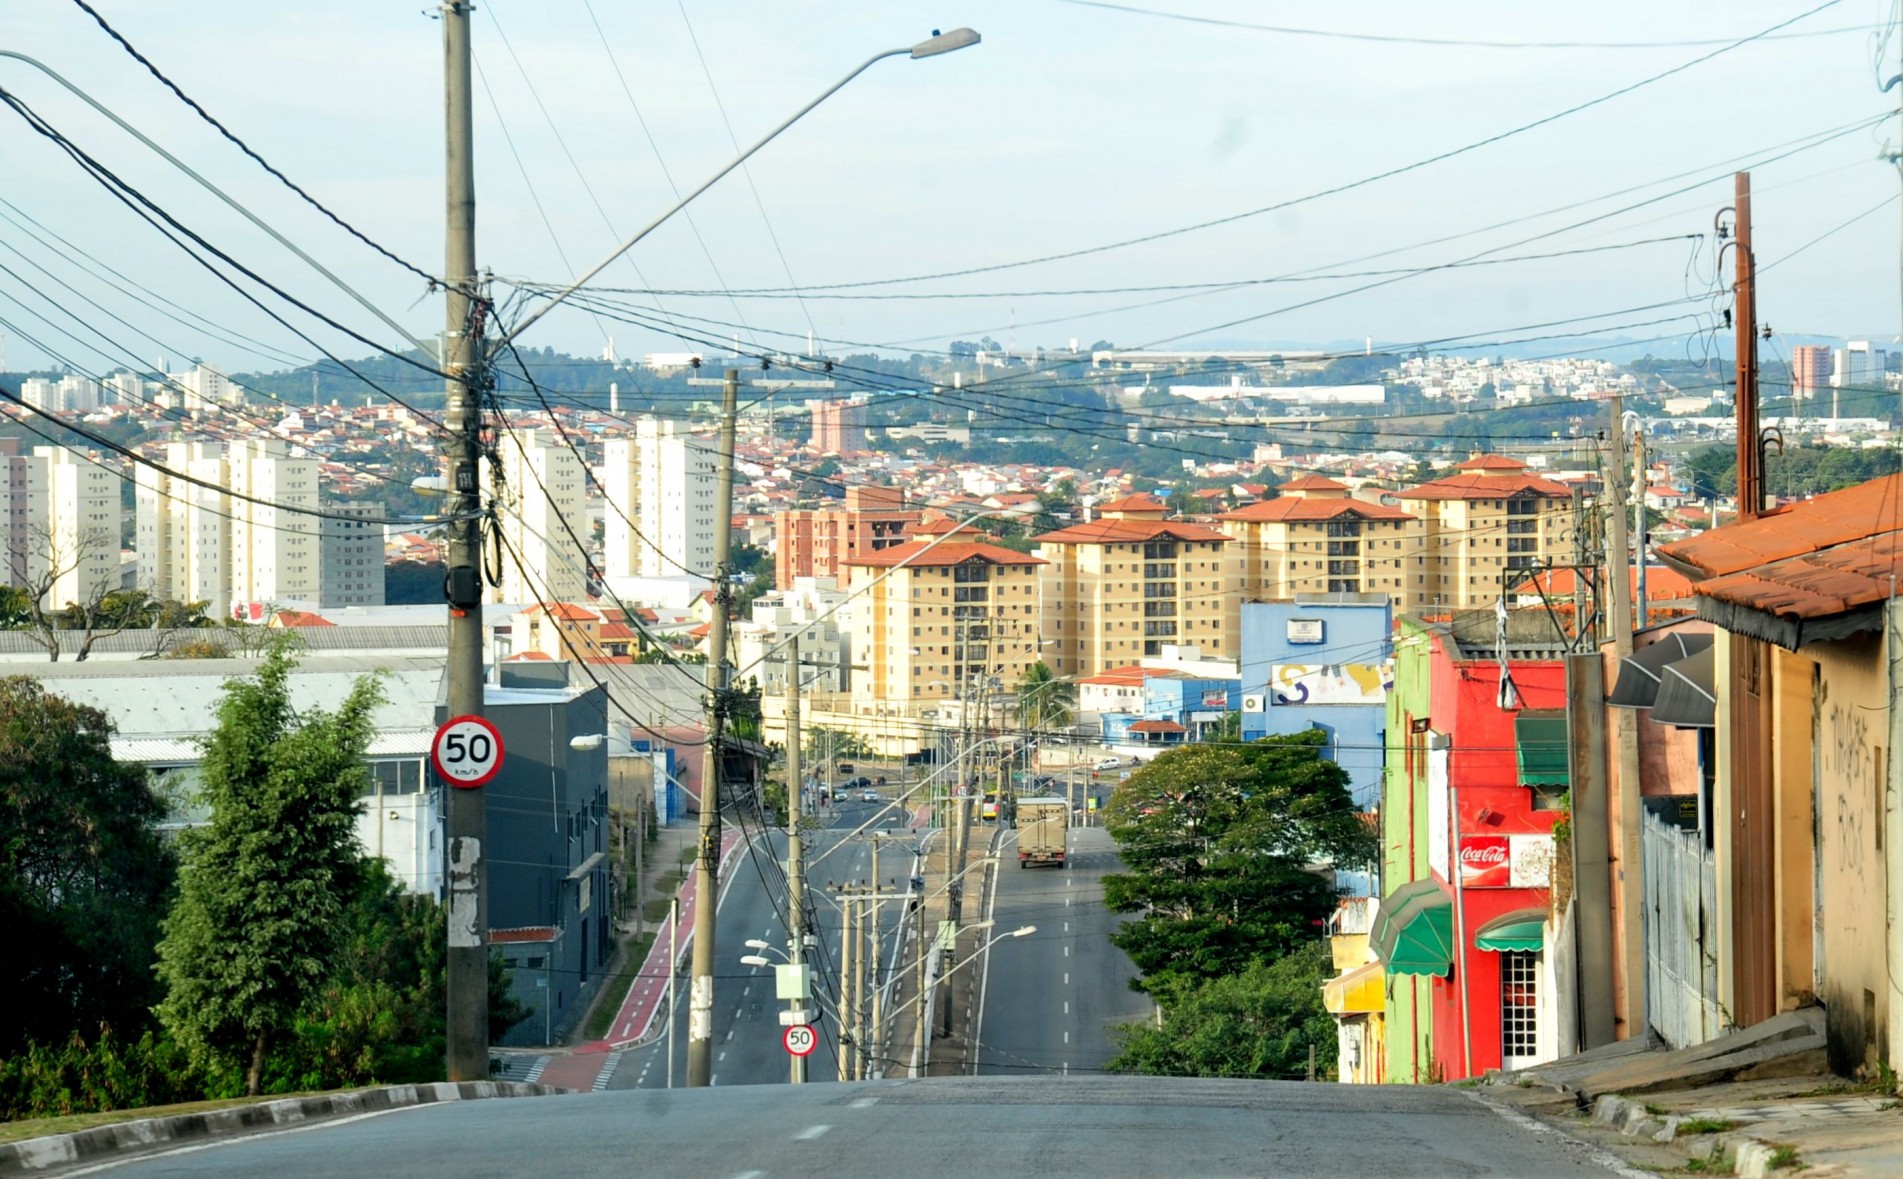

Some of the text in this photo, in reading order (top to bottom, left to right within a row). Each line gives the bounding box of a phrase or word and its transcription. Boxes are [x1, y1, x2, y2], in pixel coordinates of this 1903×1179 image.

[446, 734, 491, 763] 50
[455, 767, 479, 775] km/h
[790, 1031, 810, 1045] 50
